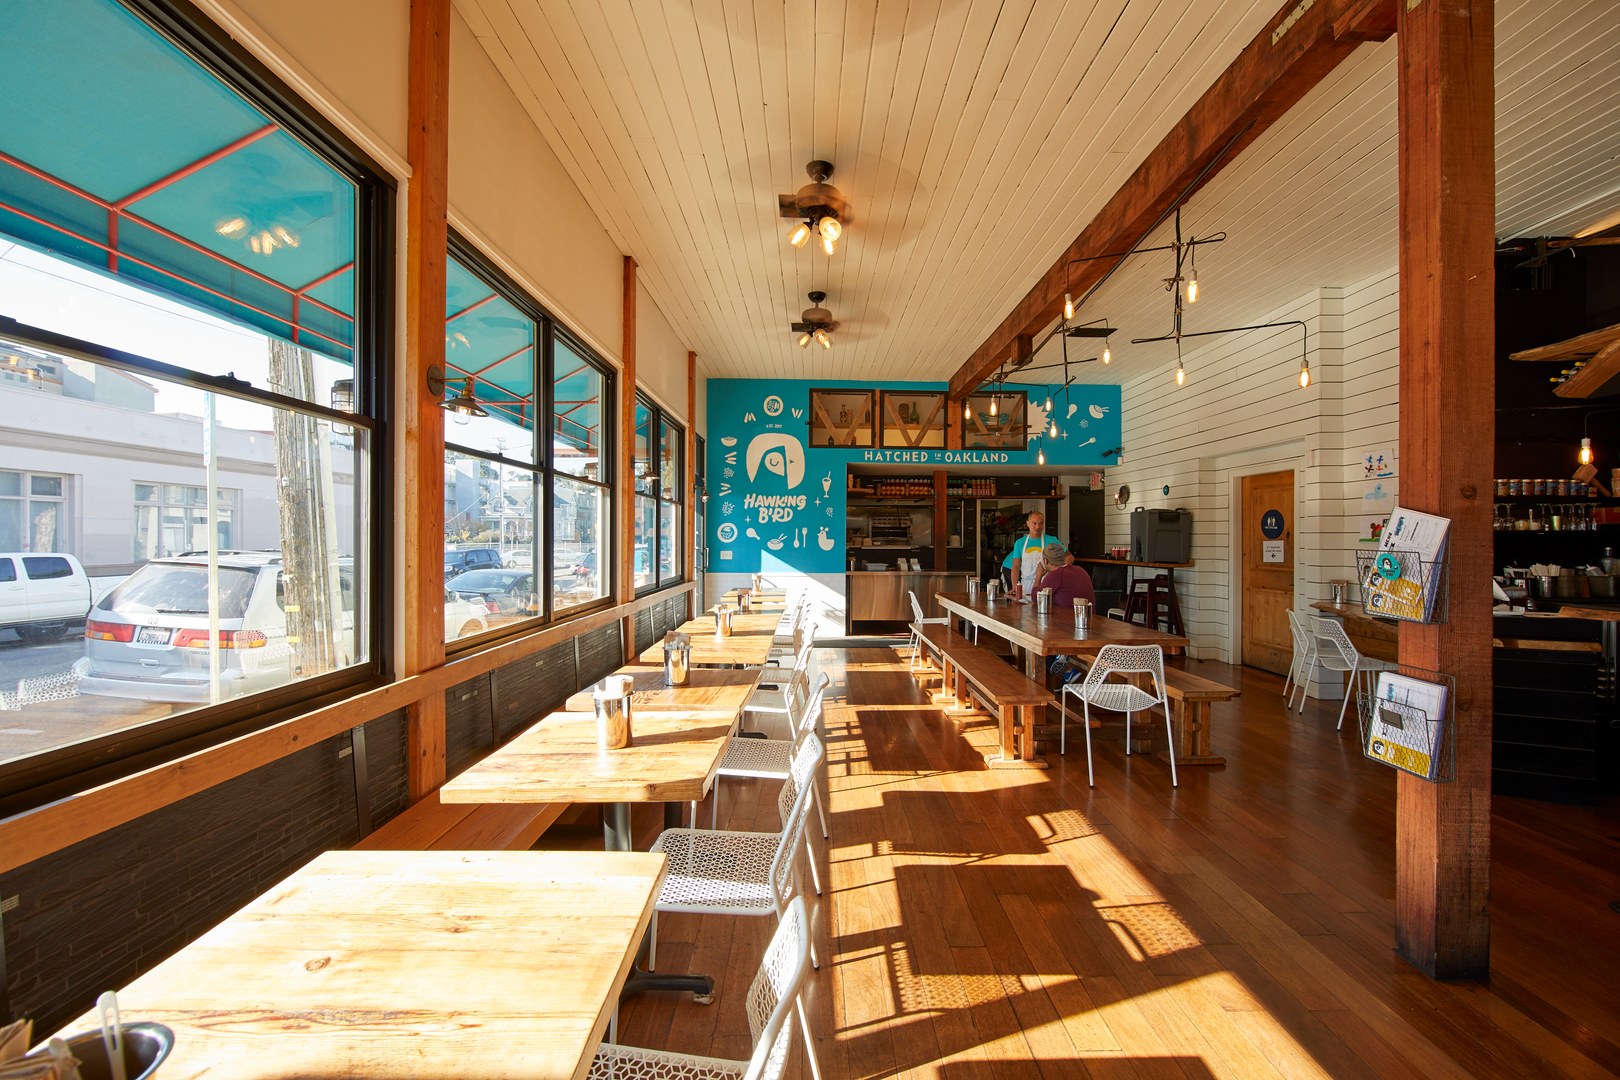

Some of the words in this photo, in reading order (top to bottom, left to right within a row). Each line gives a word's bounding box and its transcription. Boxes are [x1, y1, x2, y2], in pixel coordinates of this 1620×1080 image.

[864, 451, 928, 463] HATCHED
[944, 451, 1009, 463] OAKLAND
[744, 493, 807, 510] HAWKING
[758, 507, 794, 524] BIRD
